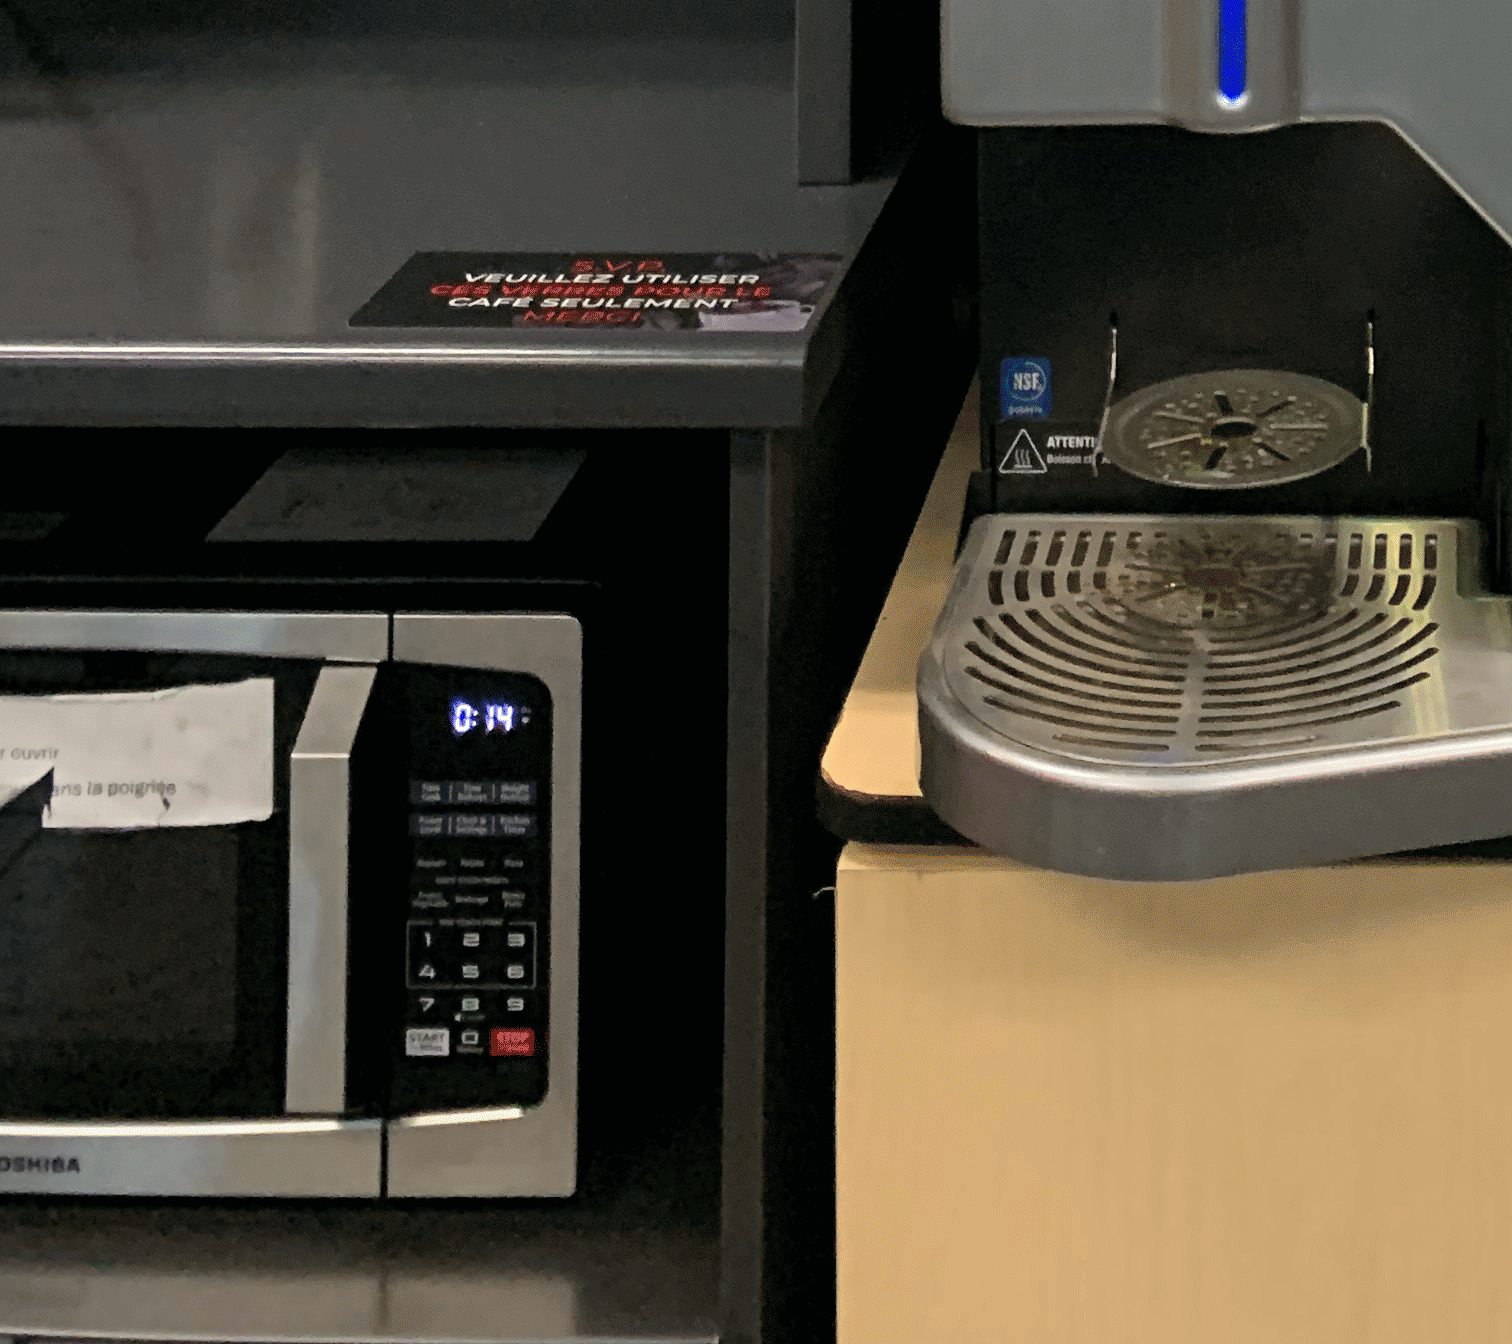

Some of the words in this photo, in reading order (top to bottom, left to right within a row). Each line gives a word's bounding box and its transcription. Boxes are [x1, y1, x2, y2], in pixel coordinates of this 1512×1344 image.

[464, 272, 615, 285] VEUILLEZ
[621, 273, 760, 285] UTILISER
[633, 286, 729, 298] POUR
[447, 296, 533, 308] CAFÉ
[539, 297, 739, 310] SEULEMENT
[522, 310, 644, 323] MERCI
[1013, 372, 1040, 391] NSF
[1046, 435, 1097, 448] ATTENTI
[451, 702, 514, 732] 0:14
[10, 747, 60, 760] ouvrir
[51, 782, 83, 797] ans
[86, 781, 104, 796] la
[424, 931, 432, 947] 1
[418, 964, 436, 980] 4
[461, 964, 480, 979] 5
[418, 997, 435, 1012] 7
[408, 1032, 445, 1043] START
[0, 1156, 81, 1174] OSHIBA
